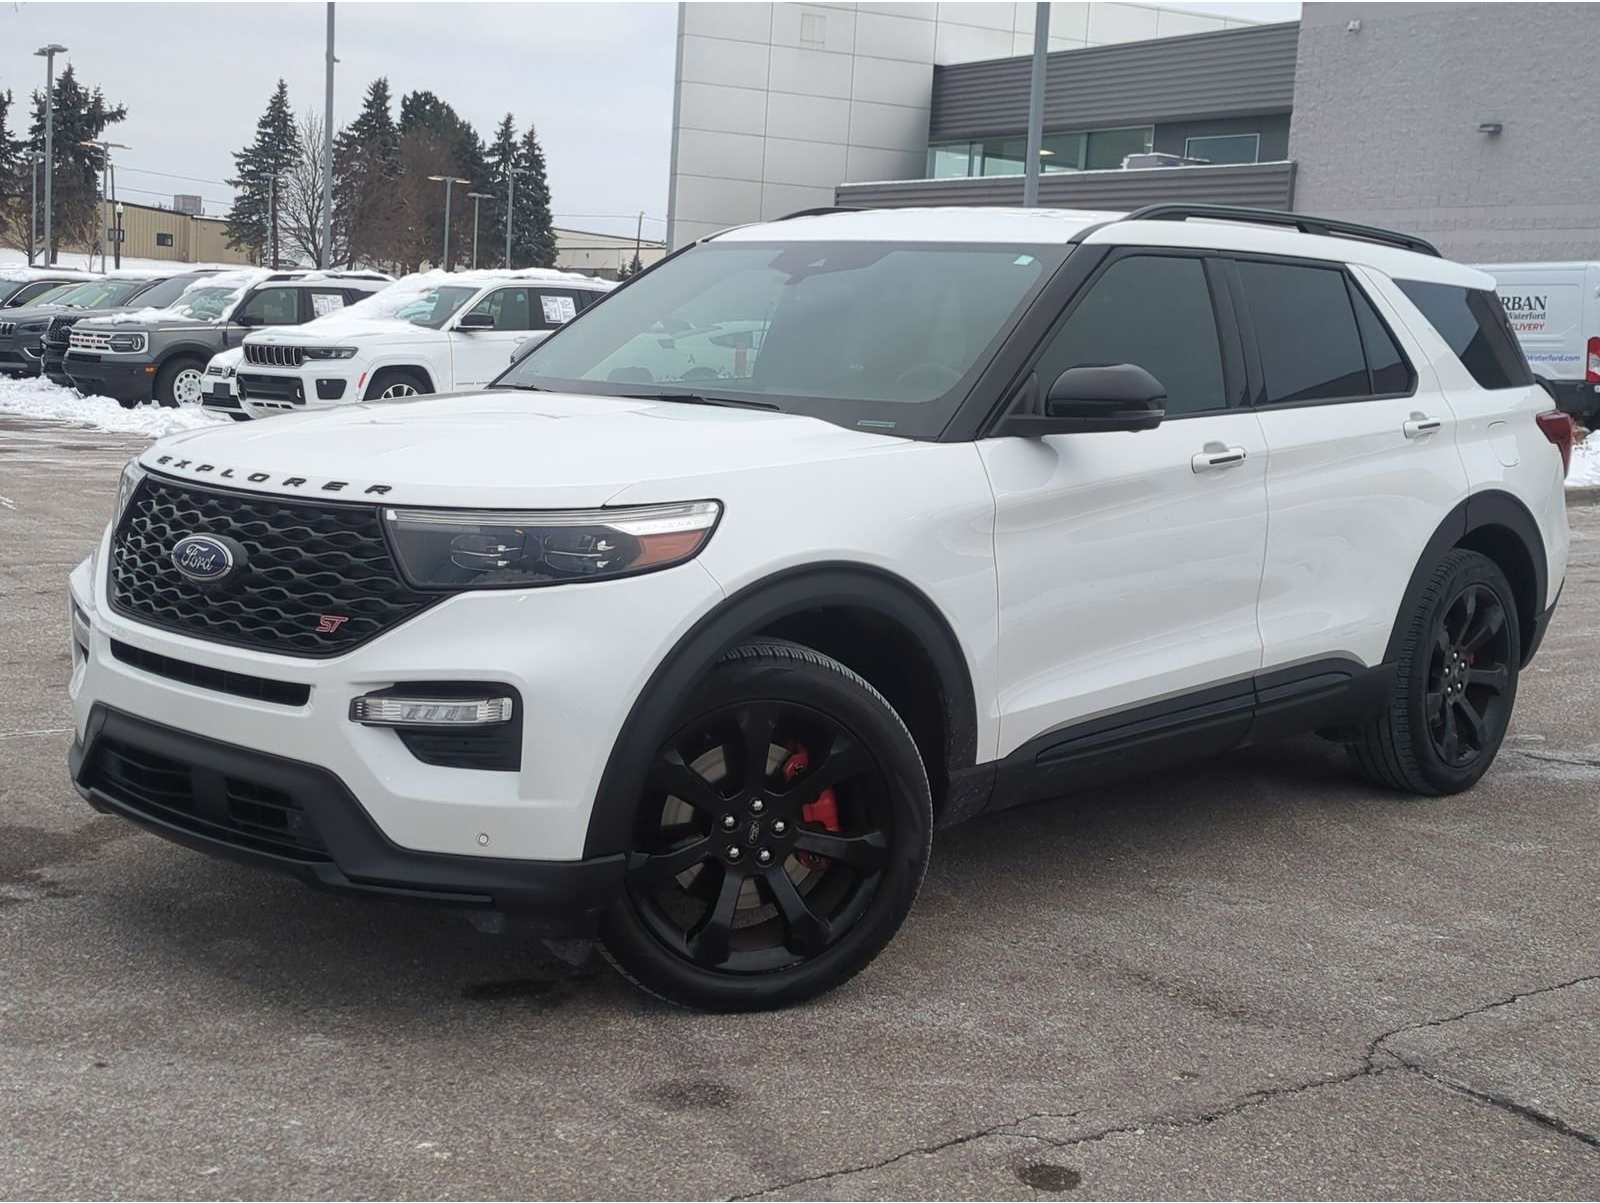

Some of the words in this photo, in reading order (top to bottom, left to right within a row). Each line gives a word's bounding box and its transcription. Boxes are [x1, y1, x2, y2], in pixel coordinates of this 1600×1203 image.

[1501, 296, 1547, 311] RBAN
[156, 455, 393, 495] EXPLORER
[181, 543, 216, 571] Ford
[315, 615, 349, 632] ST
